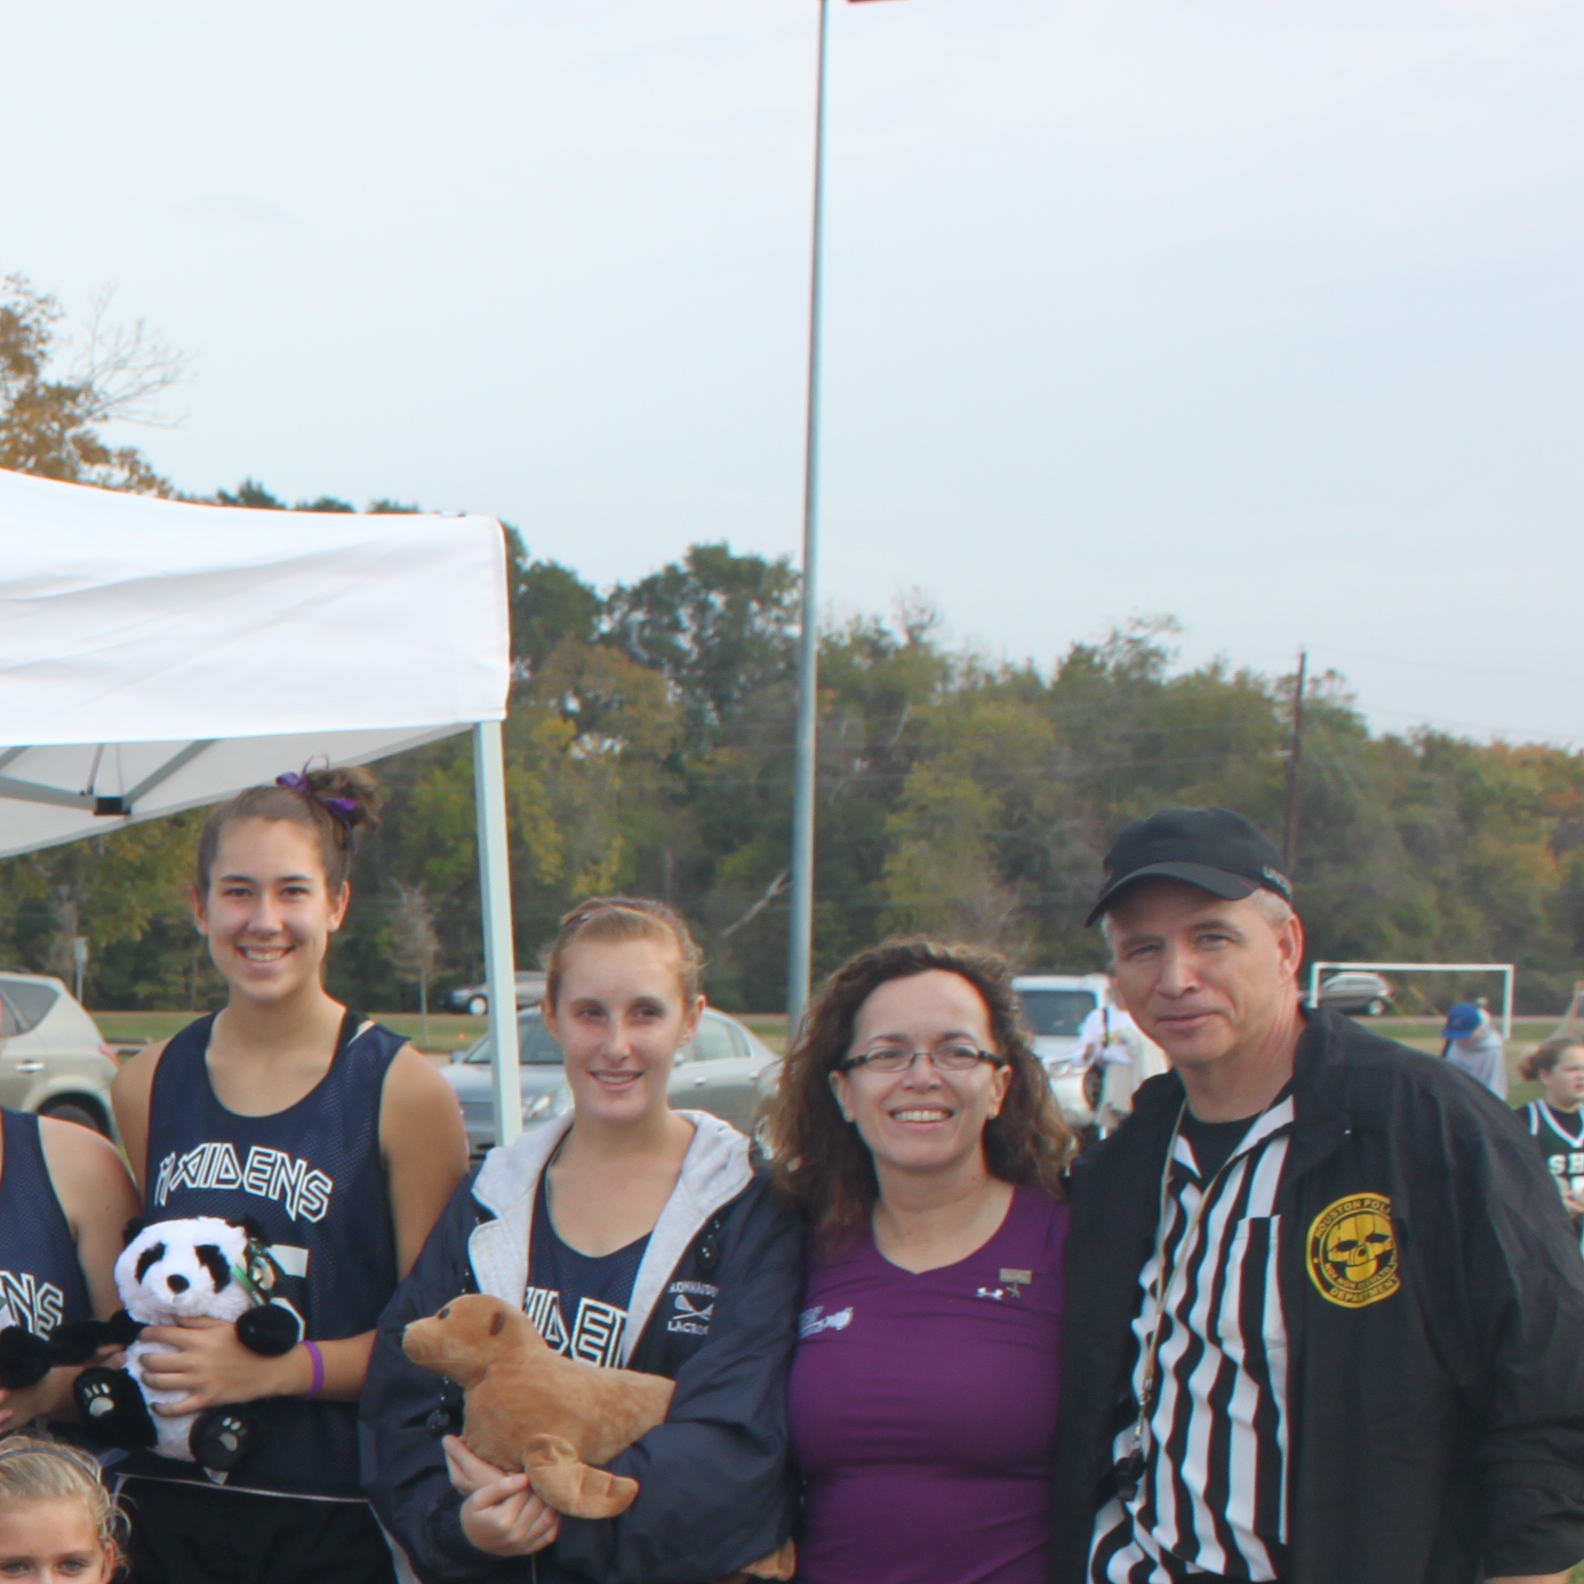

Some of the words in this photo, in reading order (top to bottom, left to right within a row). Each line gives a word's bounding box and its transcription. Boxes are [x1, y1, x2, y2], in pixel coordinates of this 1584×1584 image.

[154, 1142, 334, 1223] MAIDENS
[1314, 1199, 1362, 1239] HOUSTON
[1363, 1199, 1391, 1215] POLI
